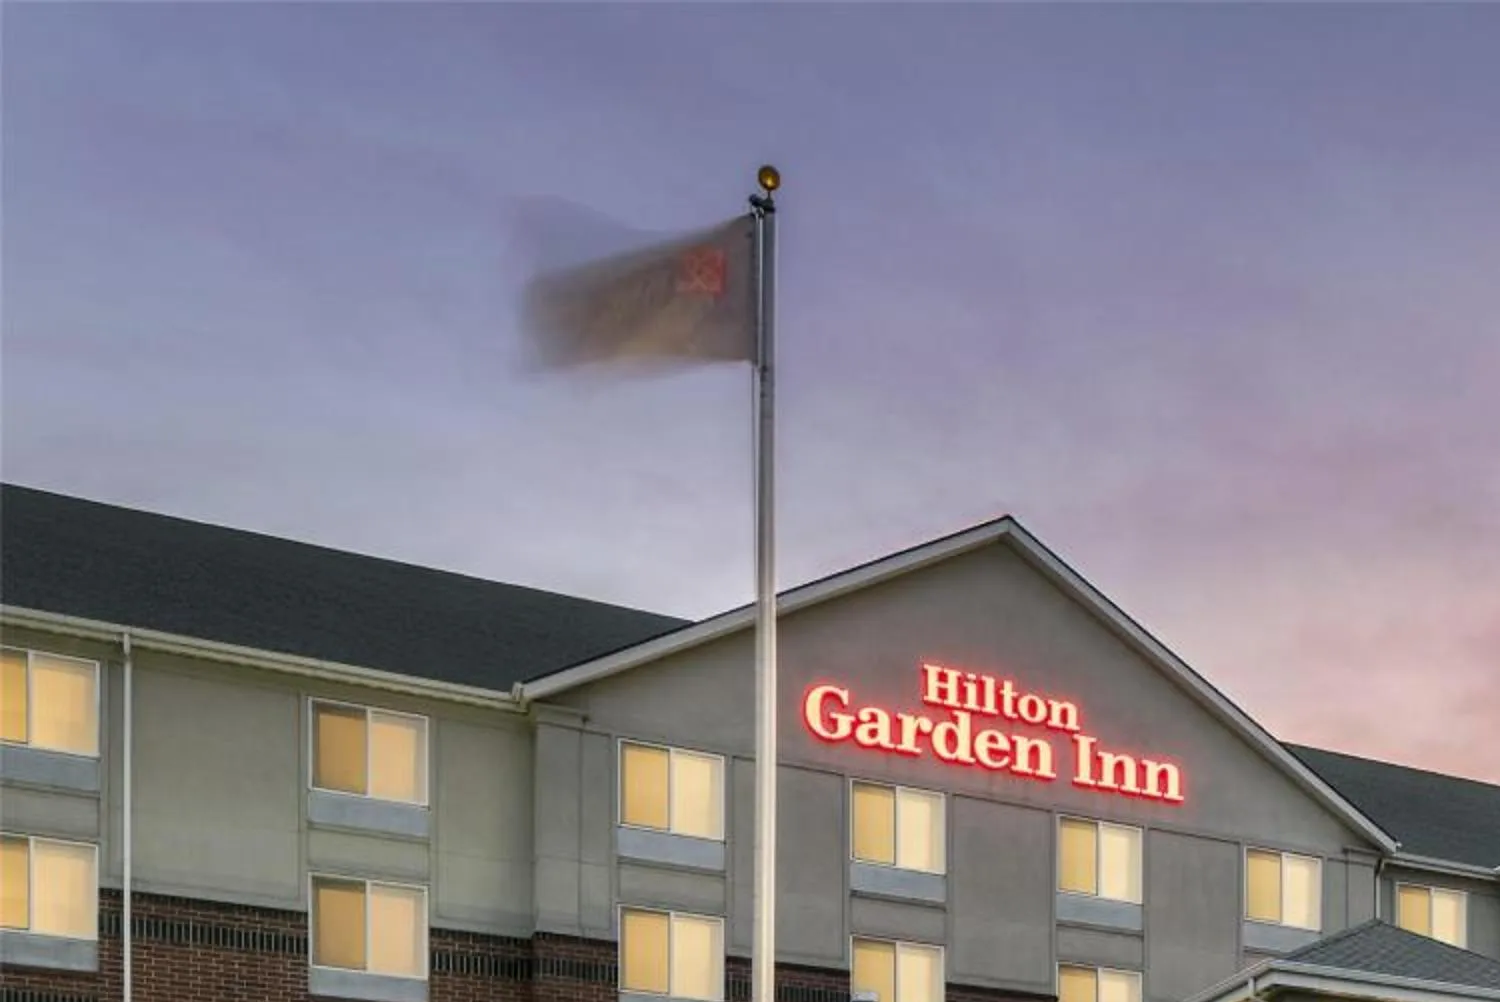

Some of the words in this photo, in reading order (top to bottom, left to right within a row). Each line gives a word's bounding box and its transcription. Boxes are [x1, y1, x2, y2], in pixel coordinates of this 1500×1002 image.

[804, 684, 1057, 780] Garden
[1071, 732, 1185, 803] Inn
[922, 662, 1081, 732] Hilton
